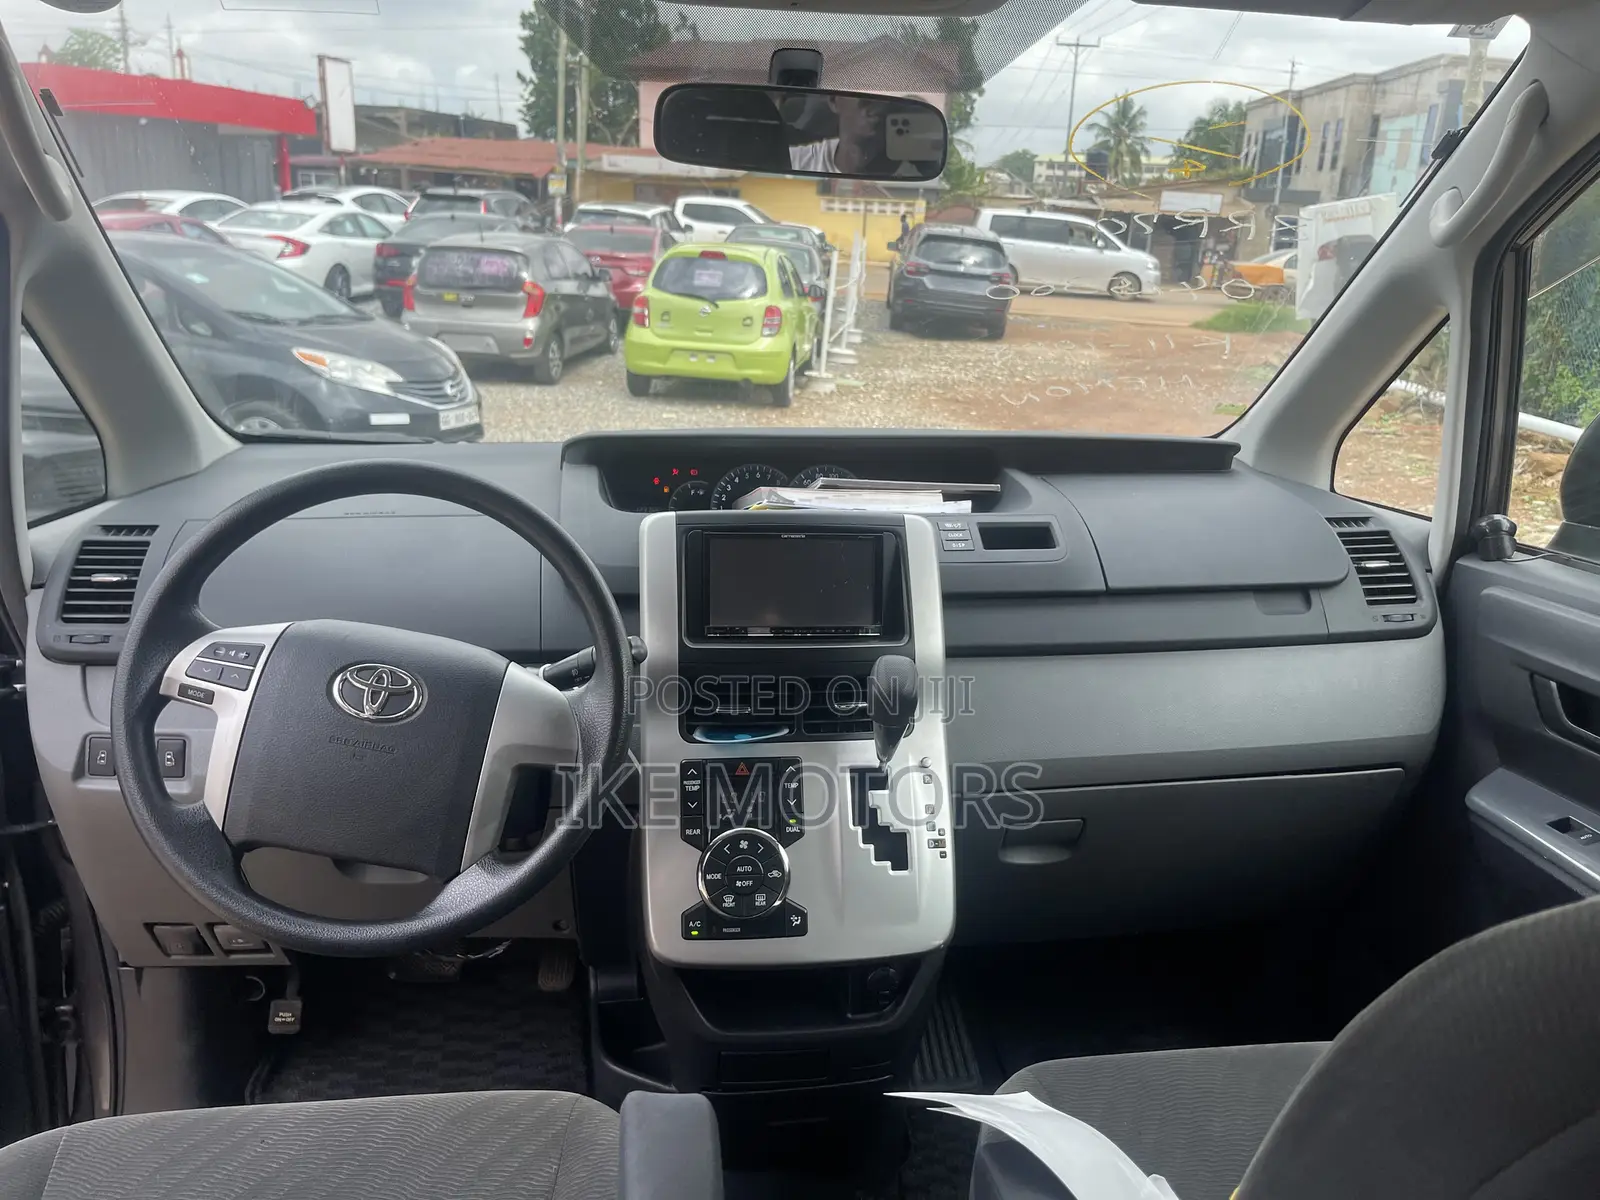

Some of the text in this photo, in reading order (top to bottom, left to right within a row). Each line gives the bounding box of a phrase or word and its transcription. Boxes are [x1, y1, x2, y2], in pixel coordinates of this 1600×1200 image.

[187, 688, 206, 699] MODE
[685, 828, 701, 836] REAR
[706, 872, 722, 880] MODE
[688, 920, 702, 928] A/C
